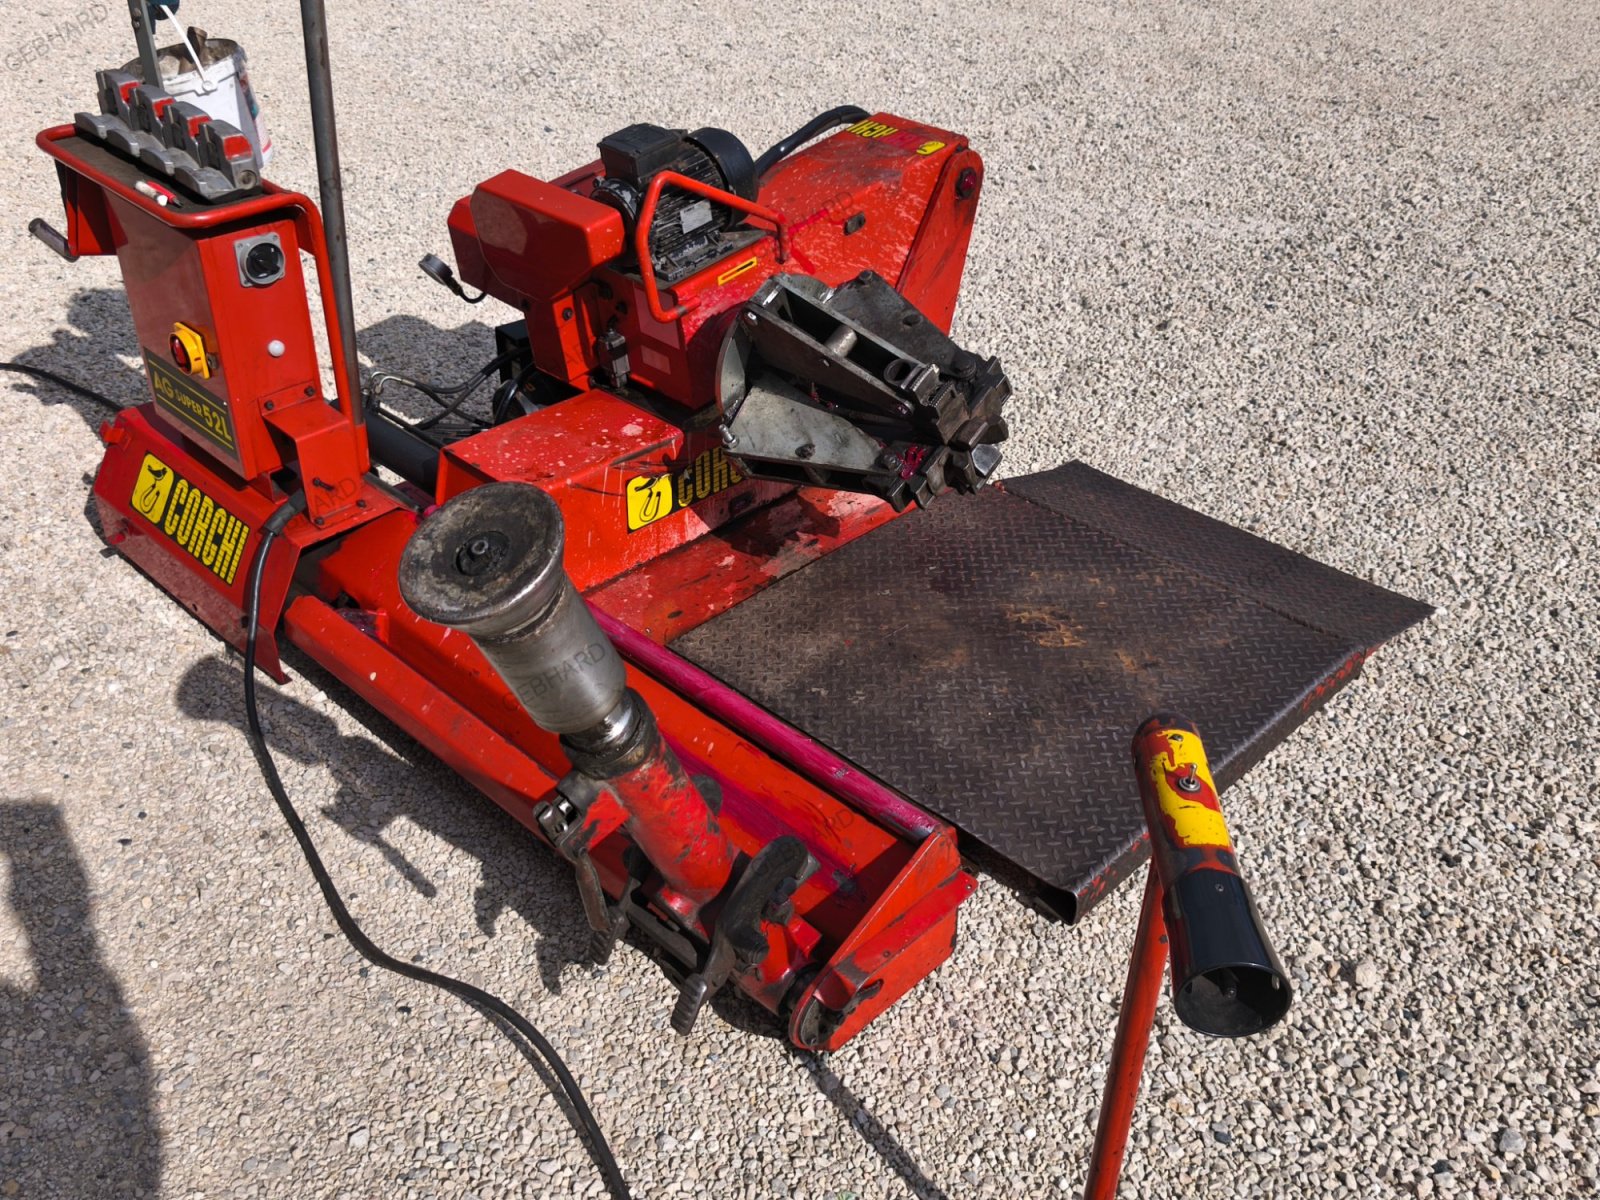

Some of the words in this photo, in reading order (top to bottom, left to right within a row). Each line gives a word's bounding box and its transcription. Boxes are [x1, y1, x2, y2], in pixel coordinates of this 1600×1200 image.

[154, 371, 175, 398] AG
[175, 389, 204, 418] SUPER
[202, 404, 233, 442] 52L
[164, 478, 250, 585] CORCHI
